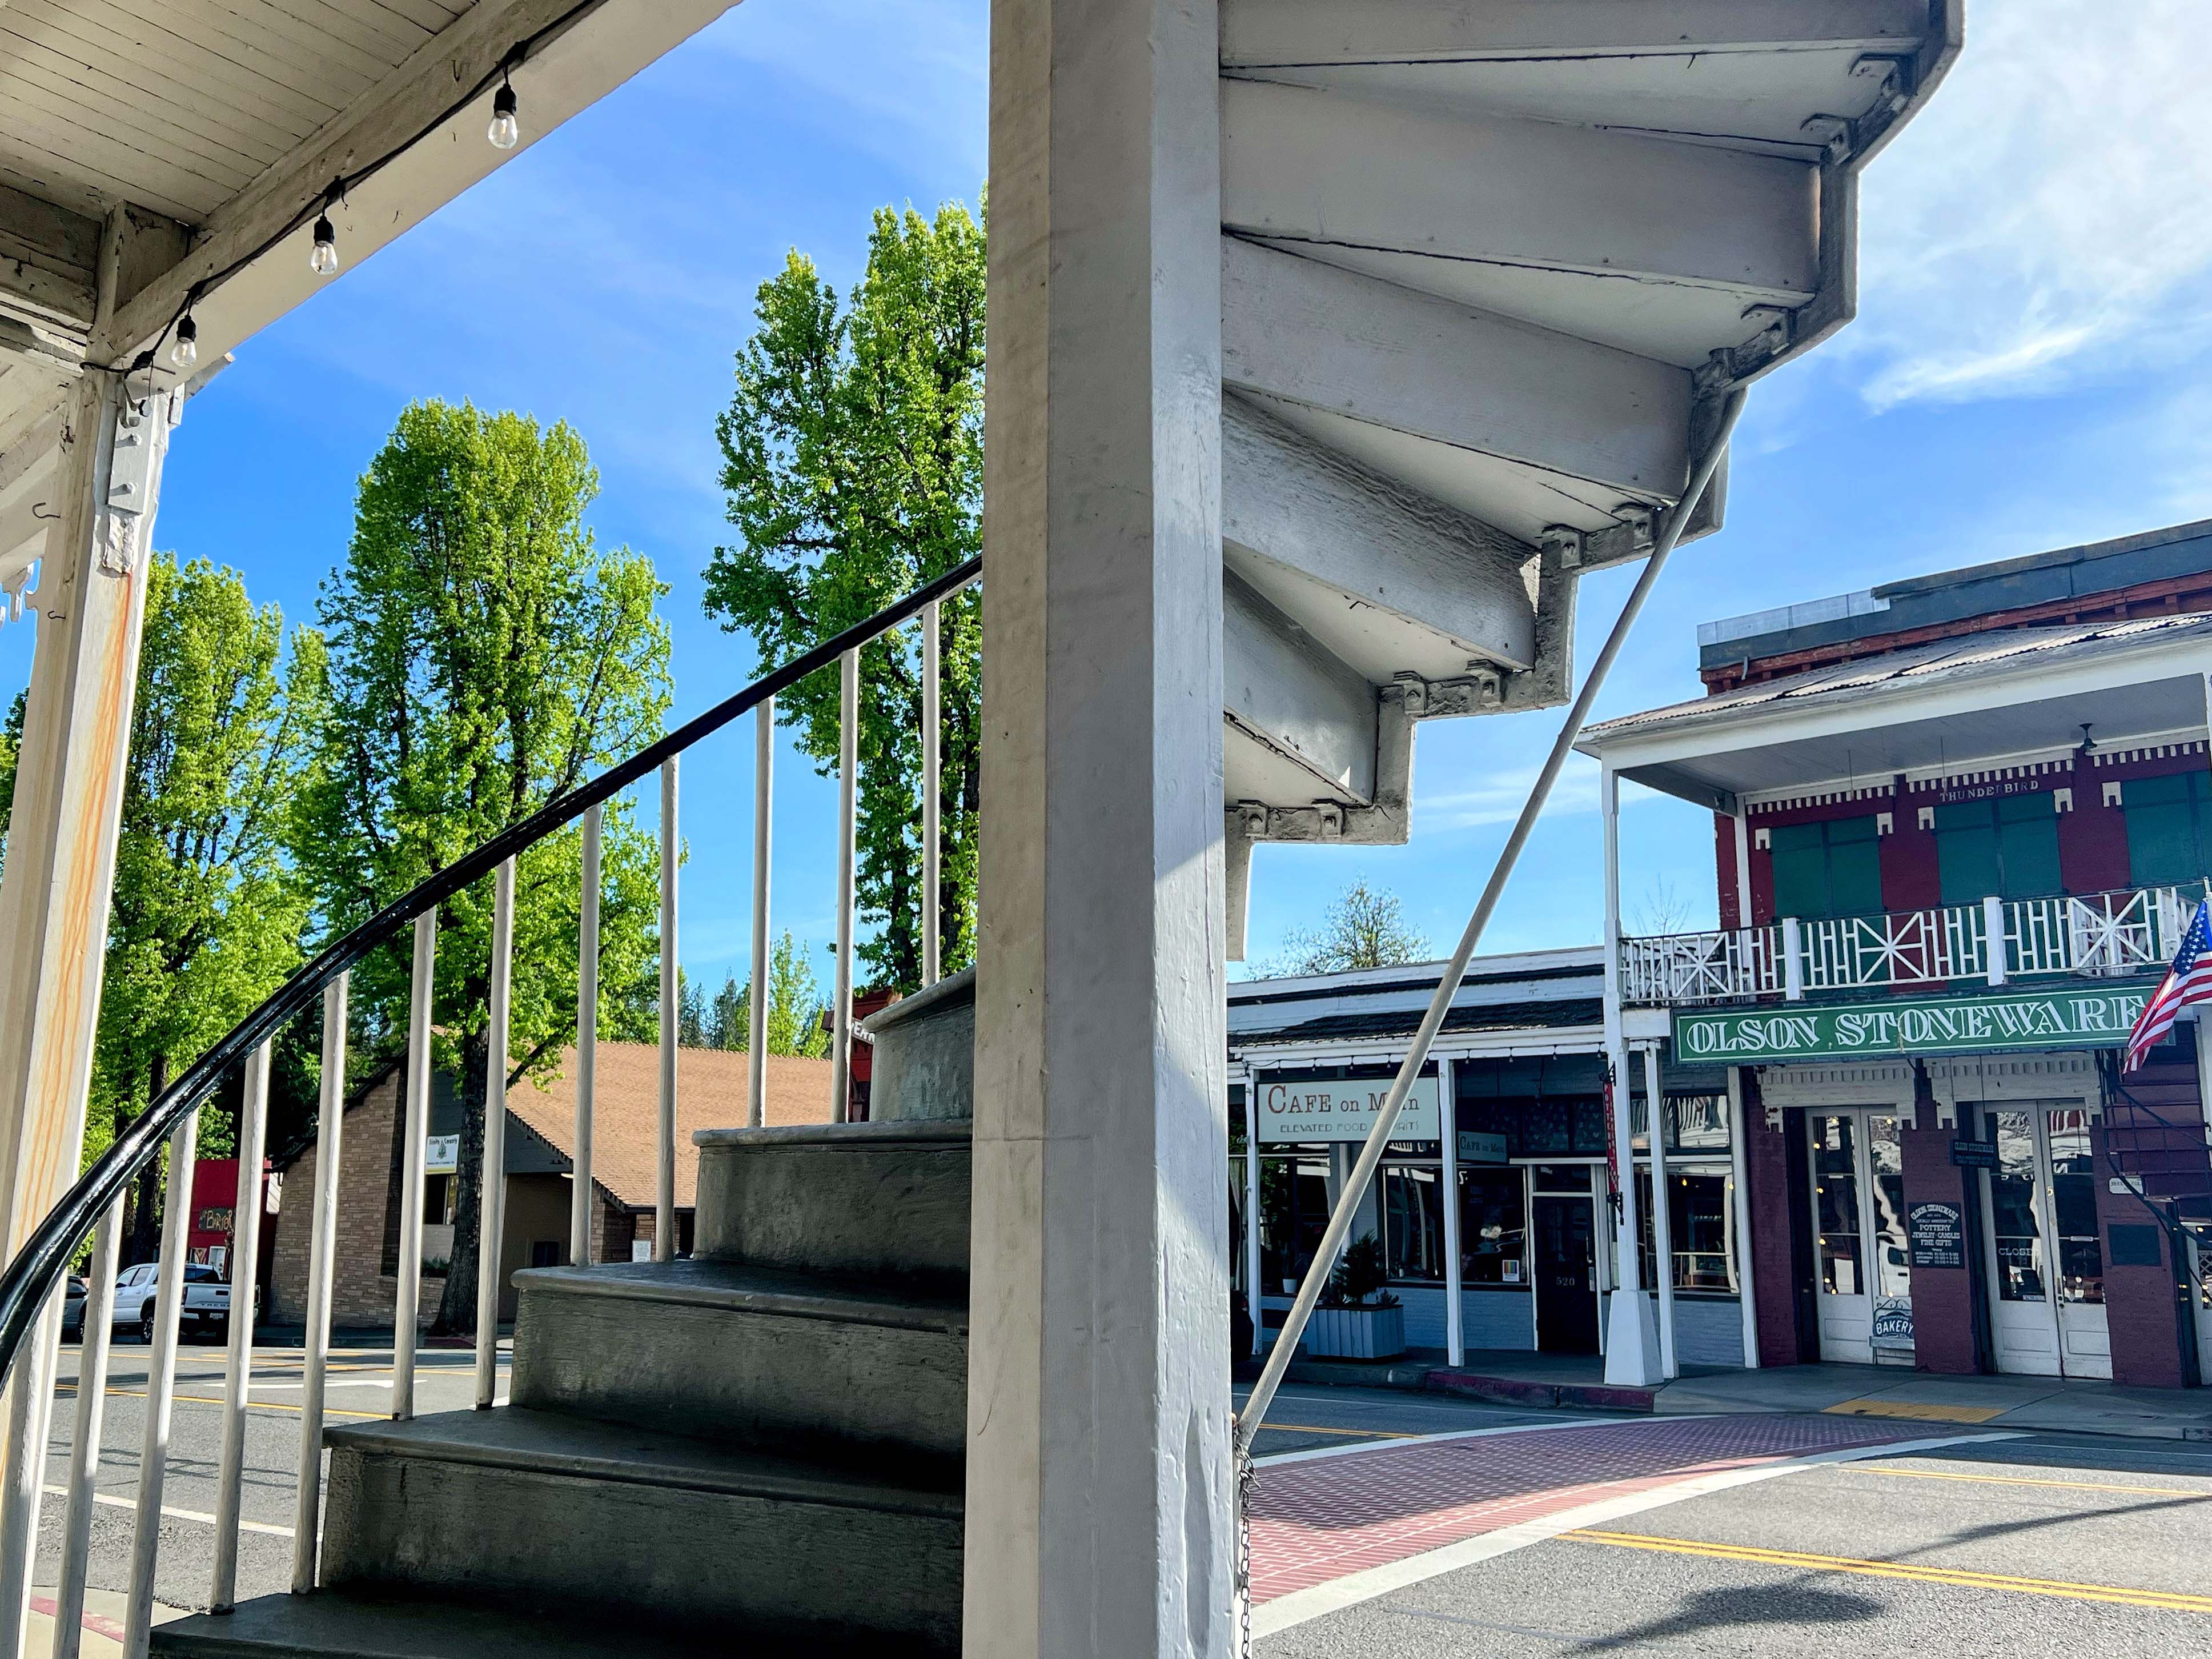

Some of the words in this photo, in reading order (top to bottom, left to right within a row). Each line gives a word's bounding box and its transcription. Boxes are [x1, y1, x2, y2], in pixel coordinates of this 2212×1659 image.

[1940, 780, 2038, 803] THUNDERBIRD
[1687, 1016, 1820, 1053] OLSON
[1835, 995, 2146, 1046] STONEWARE
[1268, 1085, 1331, 1114] CAFE
[1340, 1100, 1360, 1112] on
[1280, 1123, 1332, 1133] ELEVATED
[1556, 1276, 1575, 1287] 520
[1876, 1320, 1914, 1335] BAKERY
